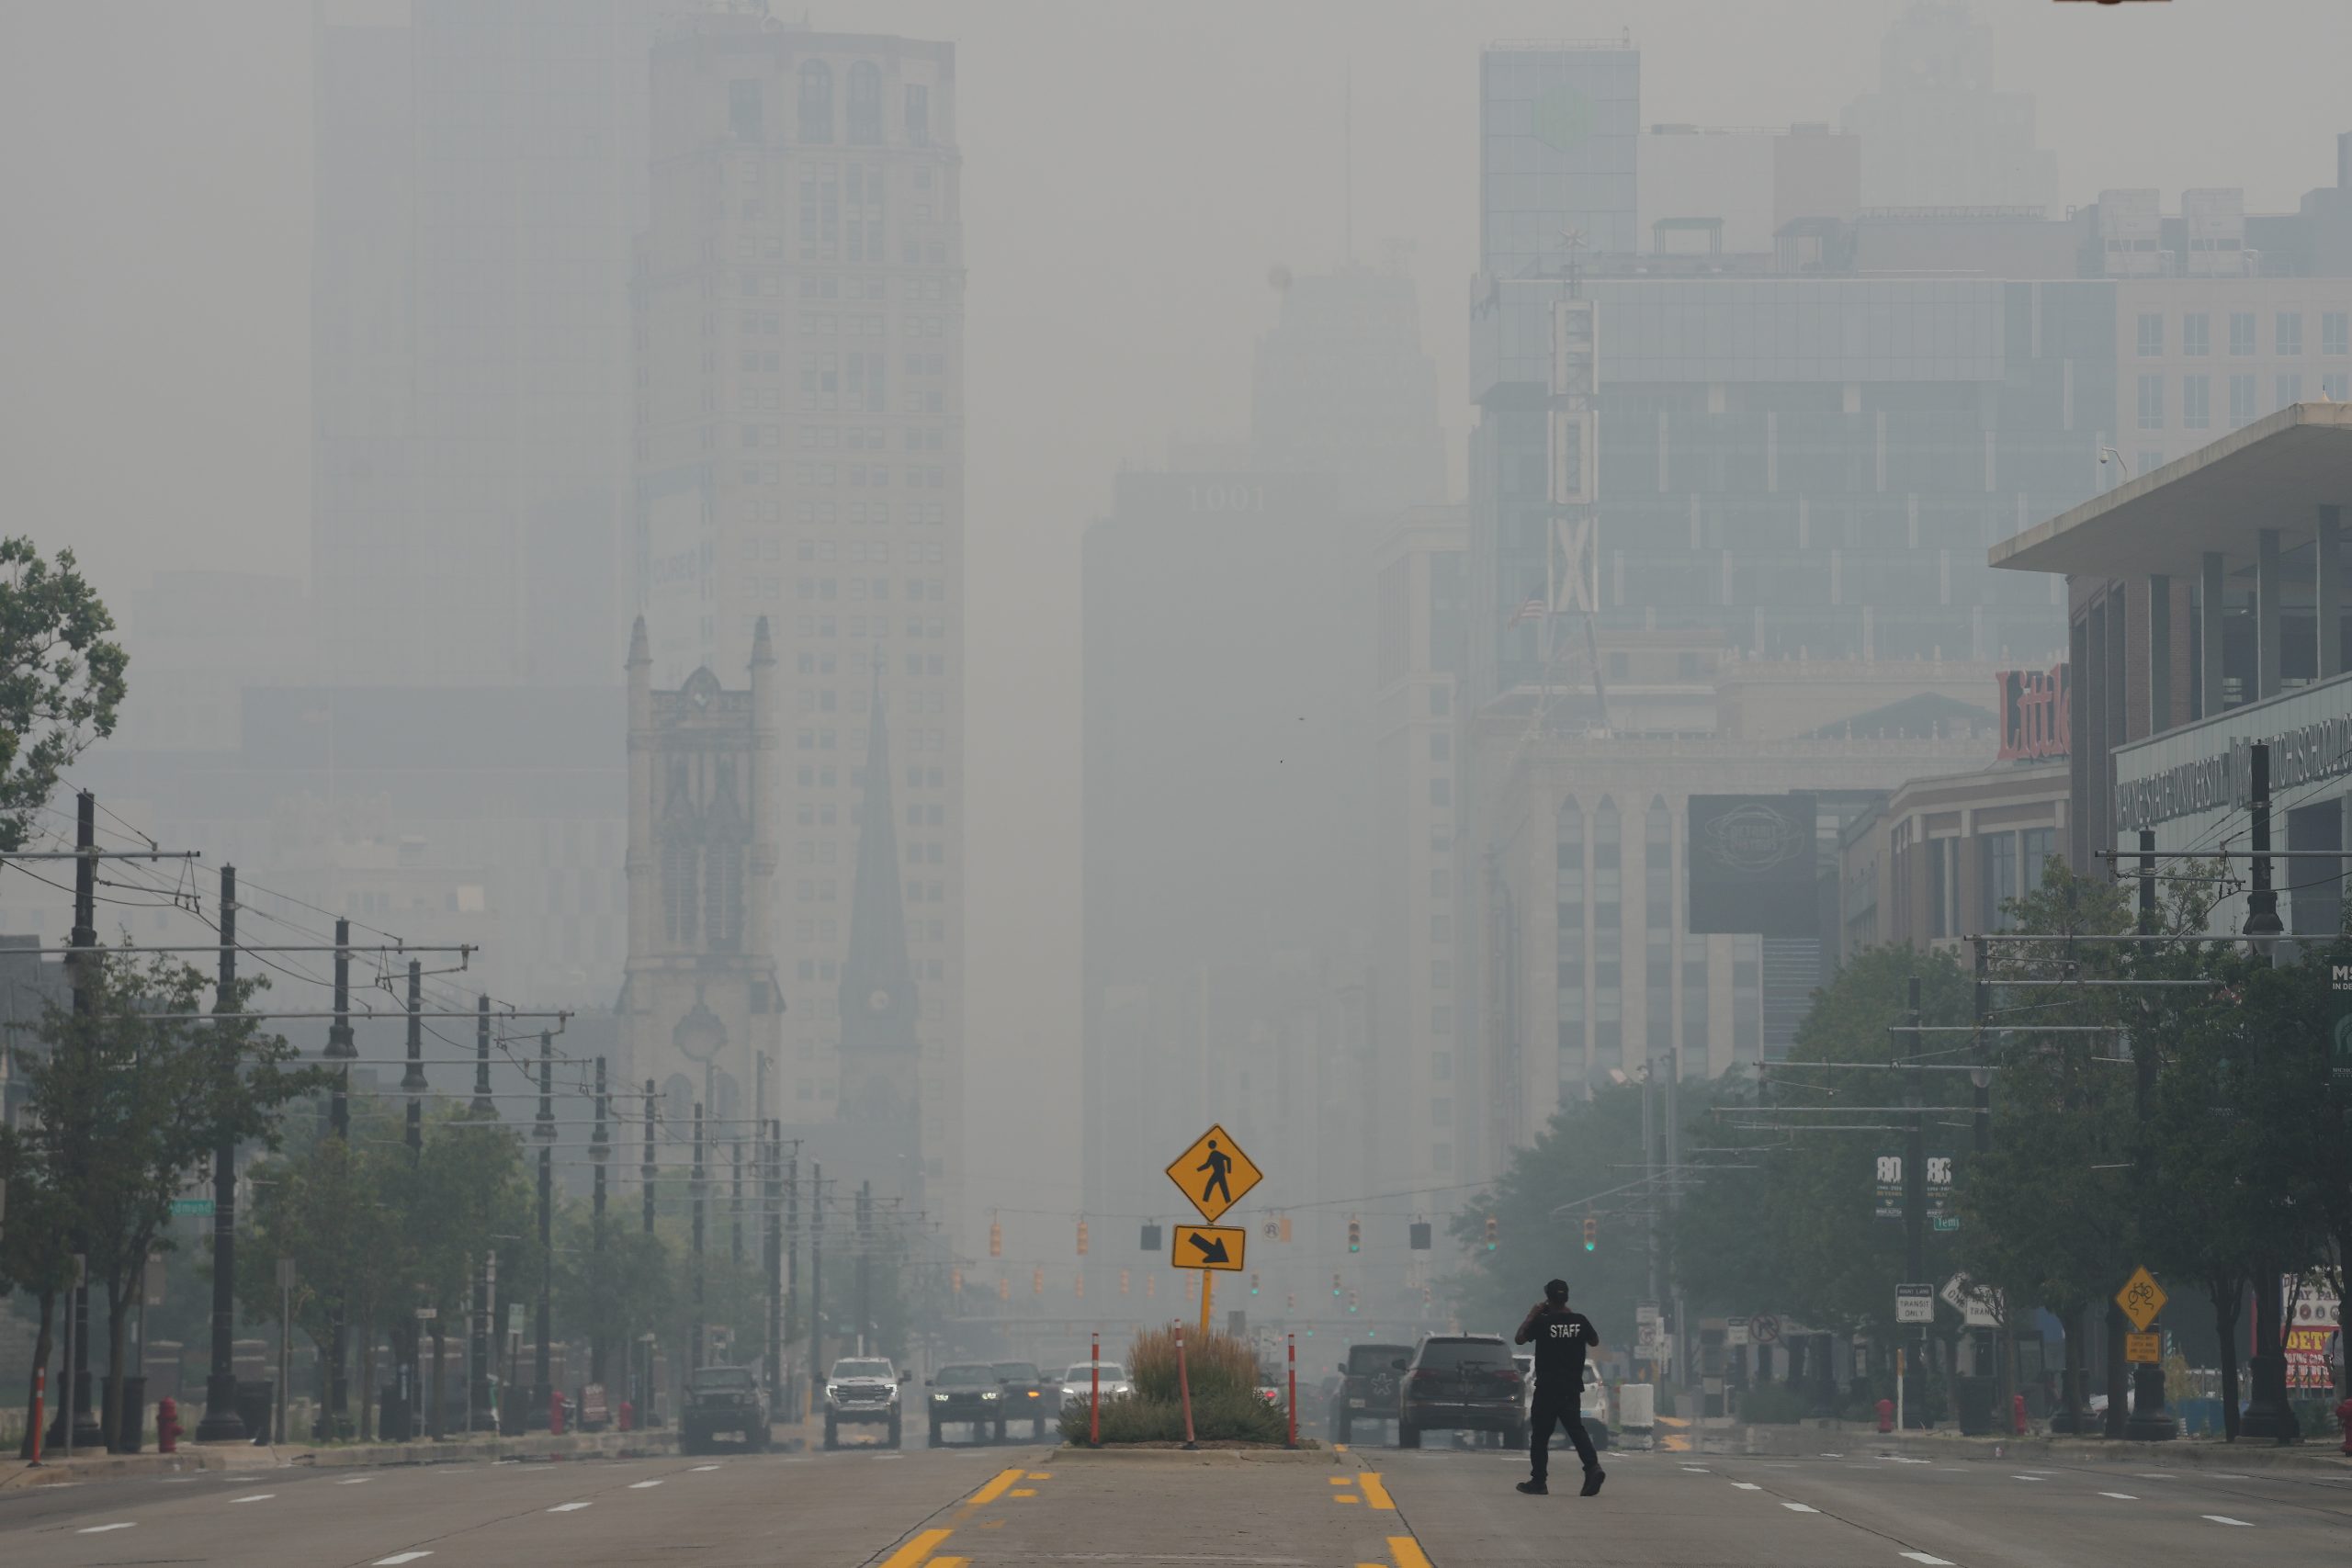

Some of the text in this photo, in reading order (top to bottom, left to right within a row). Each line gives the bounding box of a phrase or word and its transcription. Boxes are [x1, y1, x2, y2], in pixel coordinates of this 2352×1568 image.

[1187, 484, 1265, 514] 1001
[2114, 777, 2143, 828] WAYNE
[2143, 771, 2172, 824] STATE
[2174, 753, 2225, 815] UNIVERSITY
[2298, 718, 2339, 783] SCHOOL
[2342, 713, 2352, 770] O
[2333, 982, 2342, 990] IN
[1877, 1156, 1902, 1183] 80
[1550, 1323, 1581, 1338] STAFF
